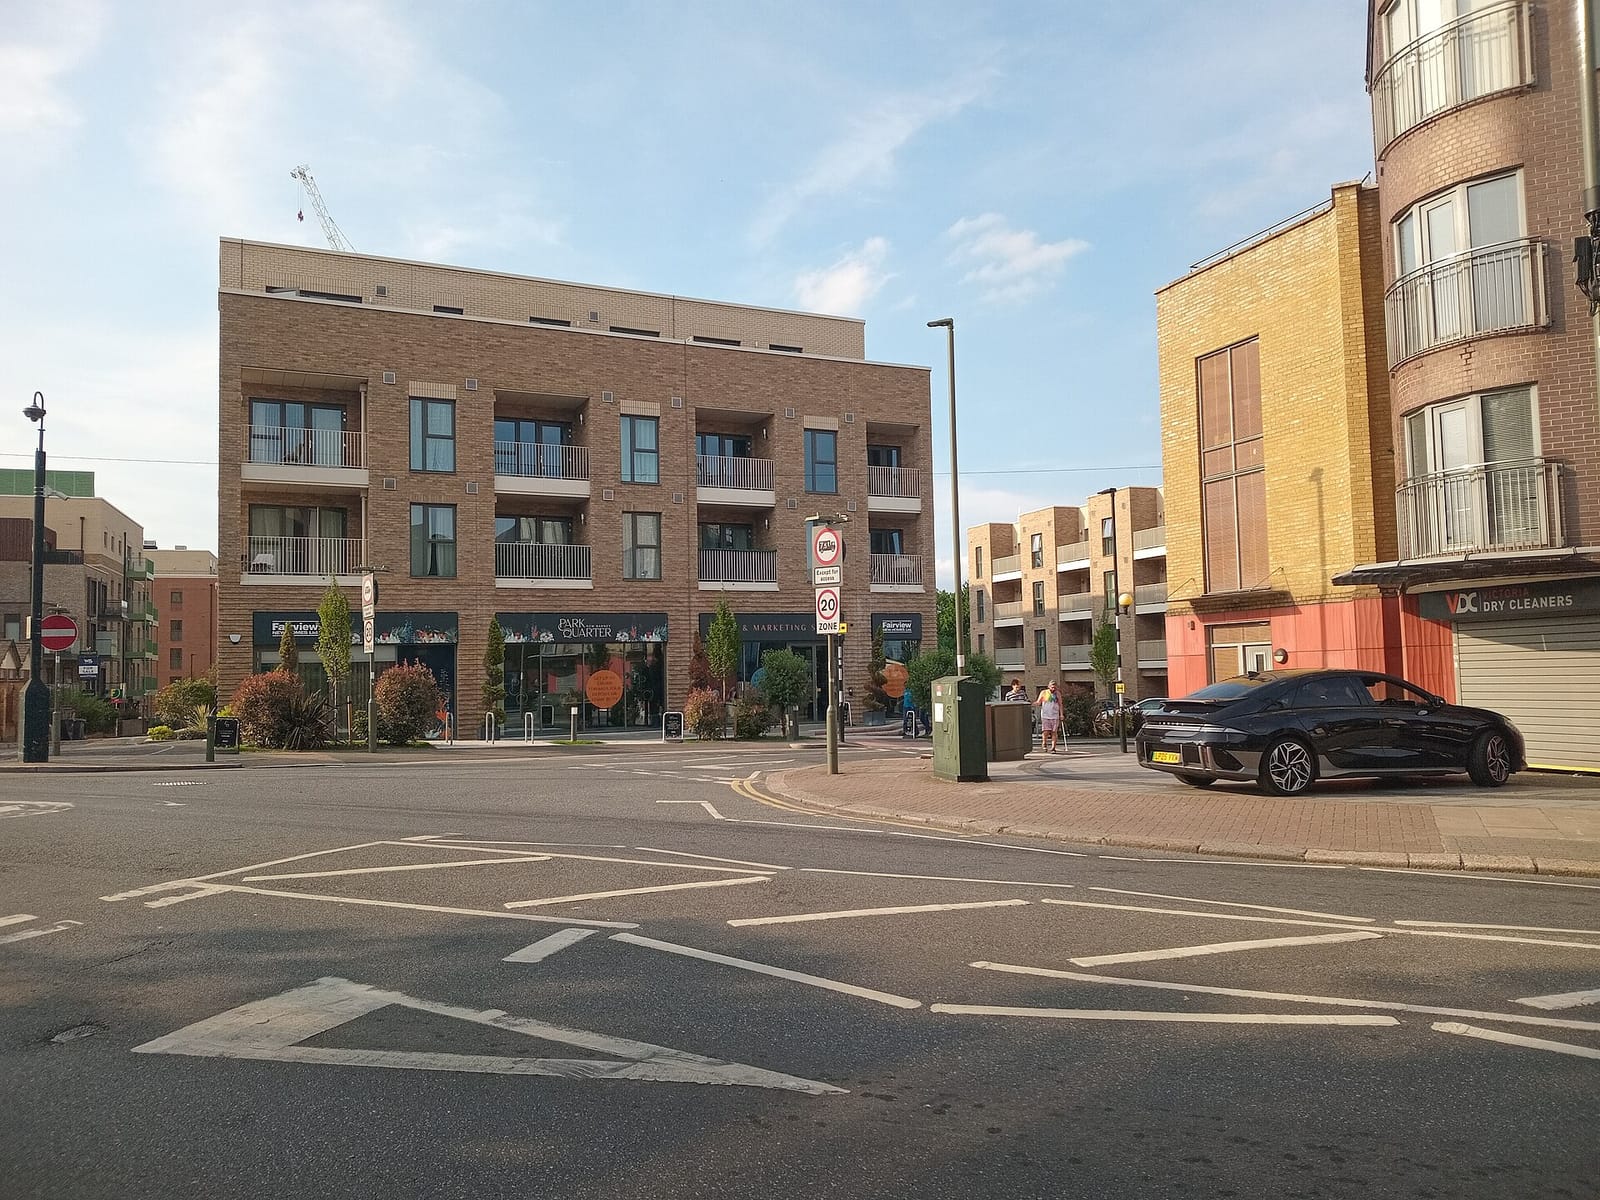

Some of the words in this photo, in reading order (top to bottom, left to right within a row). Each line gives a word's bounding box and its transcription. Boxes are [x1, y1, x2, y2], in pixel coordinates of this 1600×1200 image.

[1483, 588, 1530, 600] VICTORIA
[820, 598, 836, 612] 20
[1445, 591, 1478, 615] VDC
[1483, 600, 1505, 612] DRY
[1509, 595, 1573, 610] CLEANERS
[558, 618, 585, 630] PARK
[818, 622, 838, 631] ZONE
[563, 628, 612, 638] QUARTER
